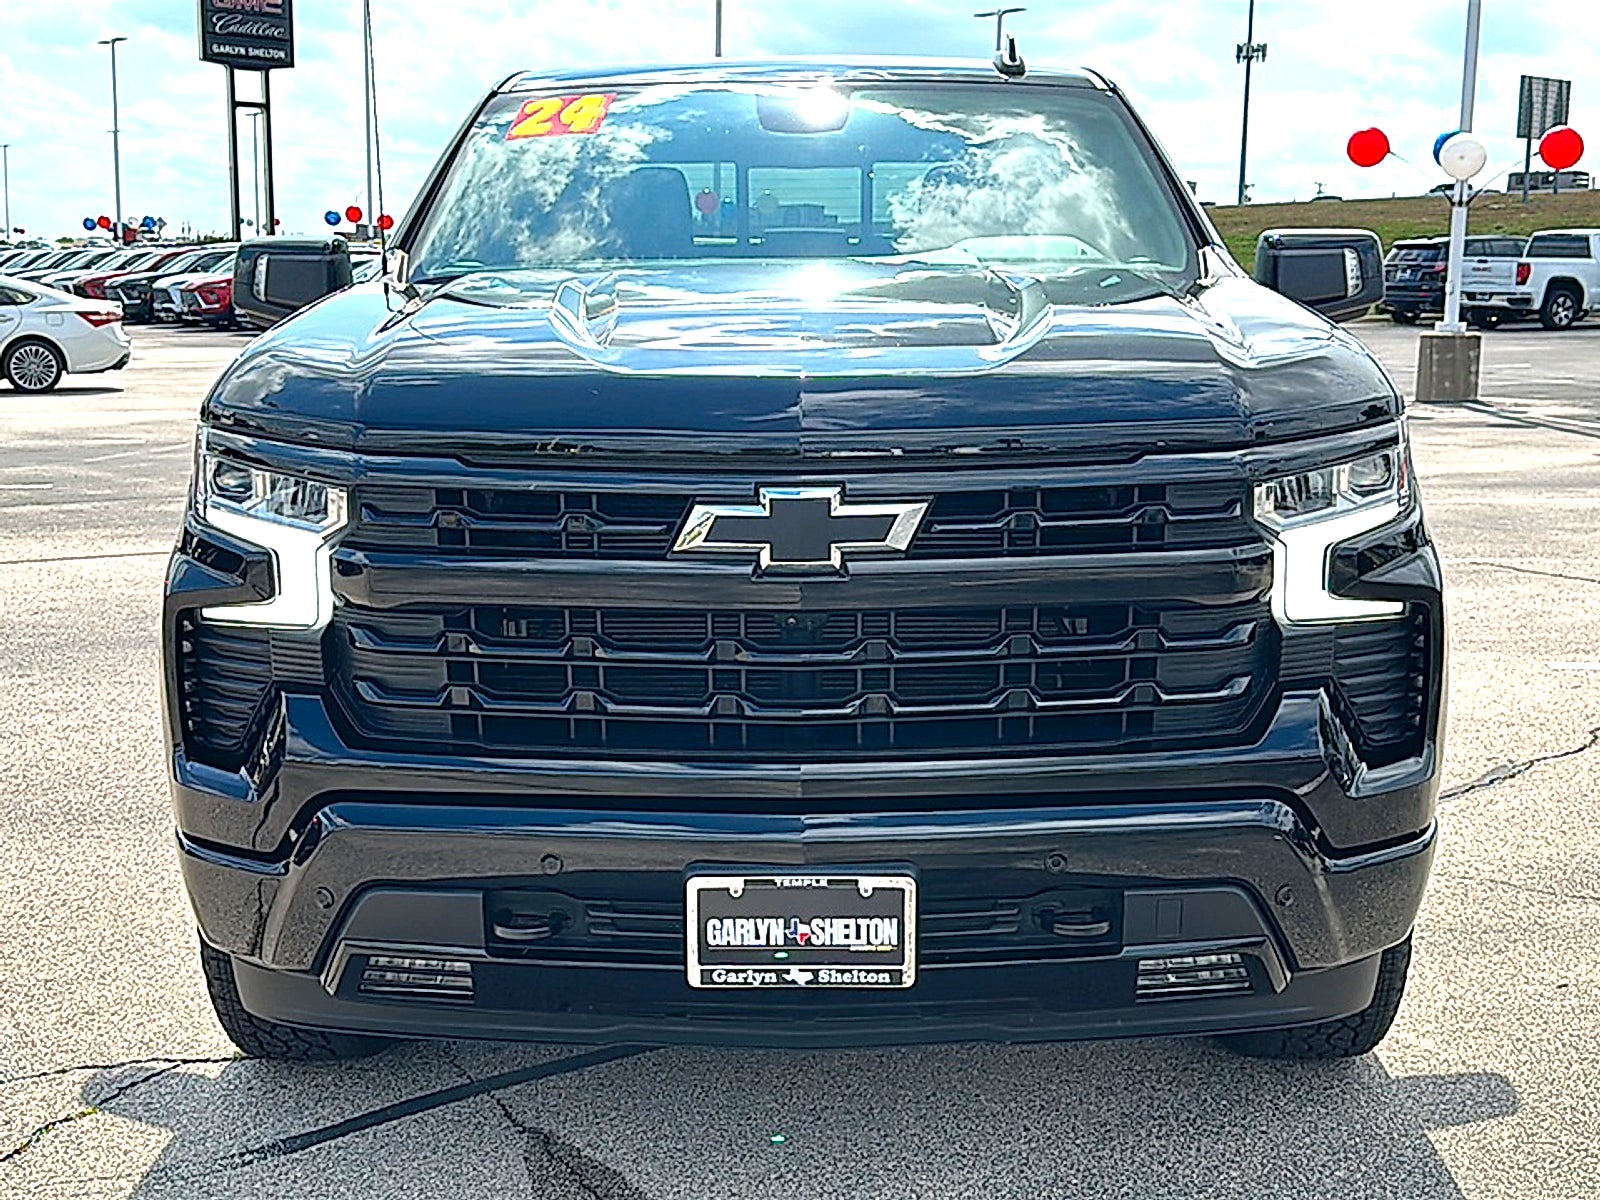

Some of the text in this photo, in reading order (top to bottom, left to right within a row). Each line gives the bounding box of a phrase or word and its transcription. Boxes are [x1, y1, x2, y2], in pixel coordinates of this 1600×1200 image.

[212, 13, 285, 38] Cadillac
[212, 43, 286, 59] GARLYN SHELTON
[511, 95, 605, 135] 24
[774, 879, 828, 887] TEMPLE
[706, 917, 899, 946] GARLYN SHELTON
[712, 970, 891, 986] Garlyn Shelton
